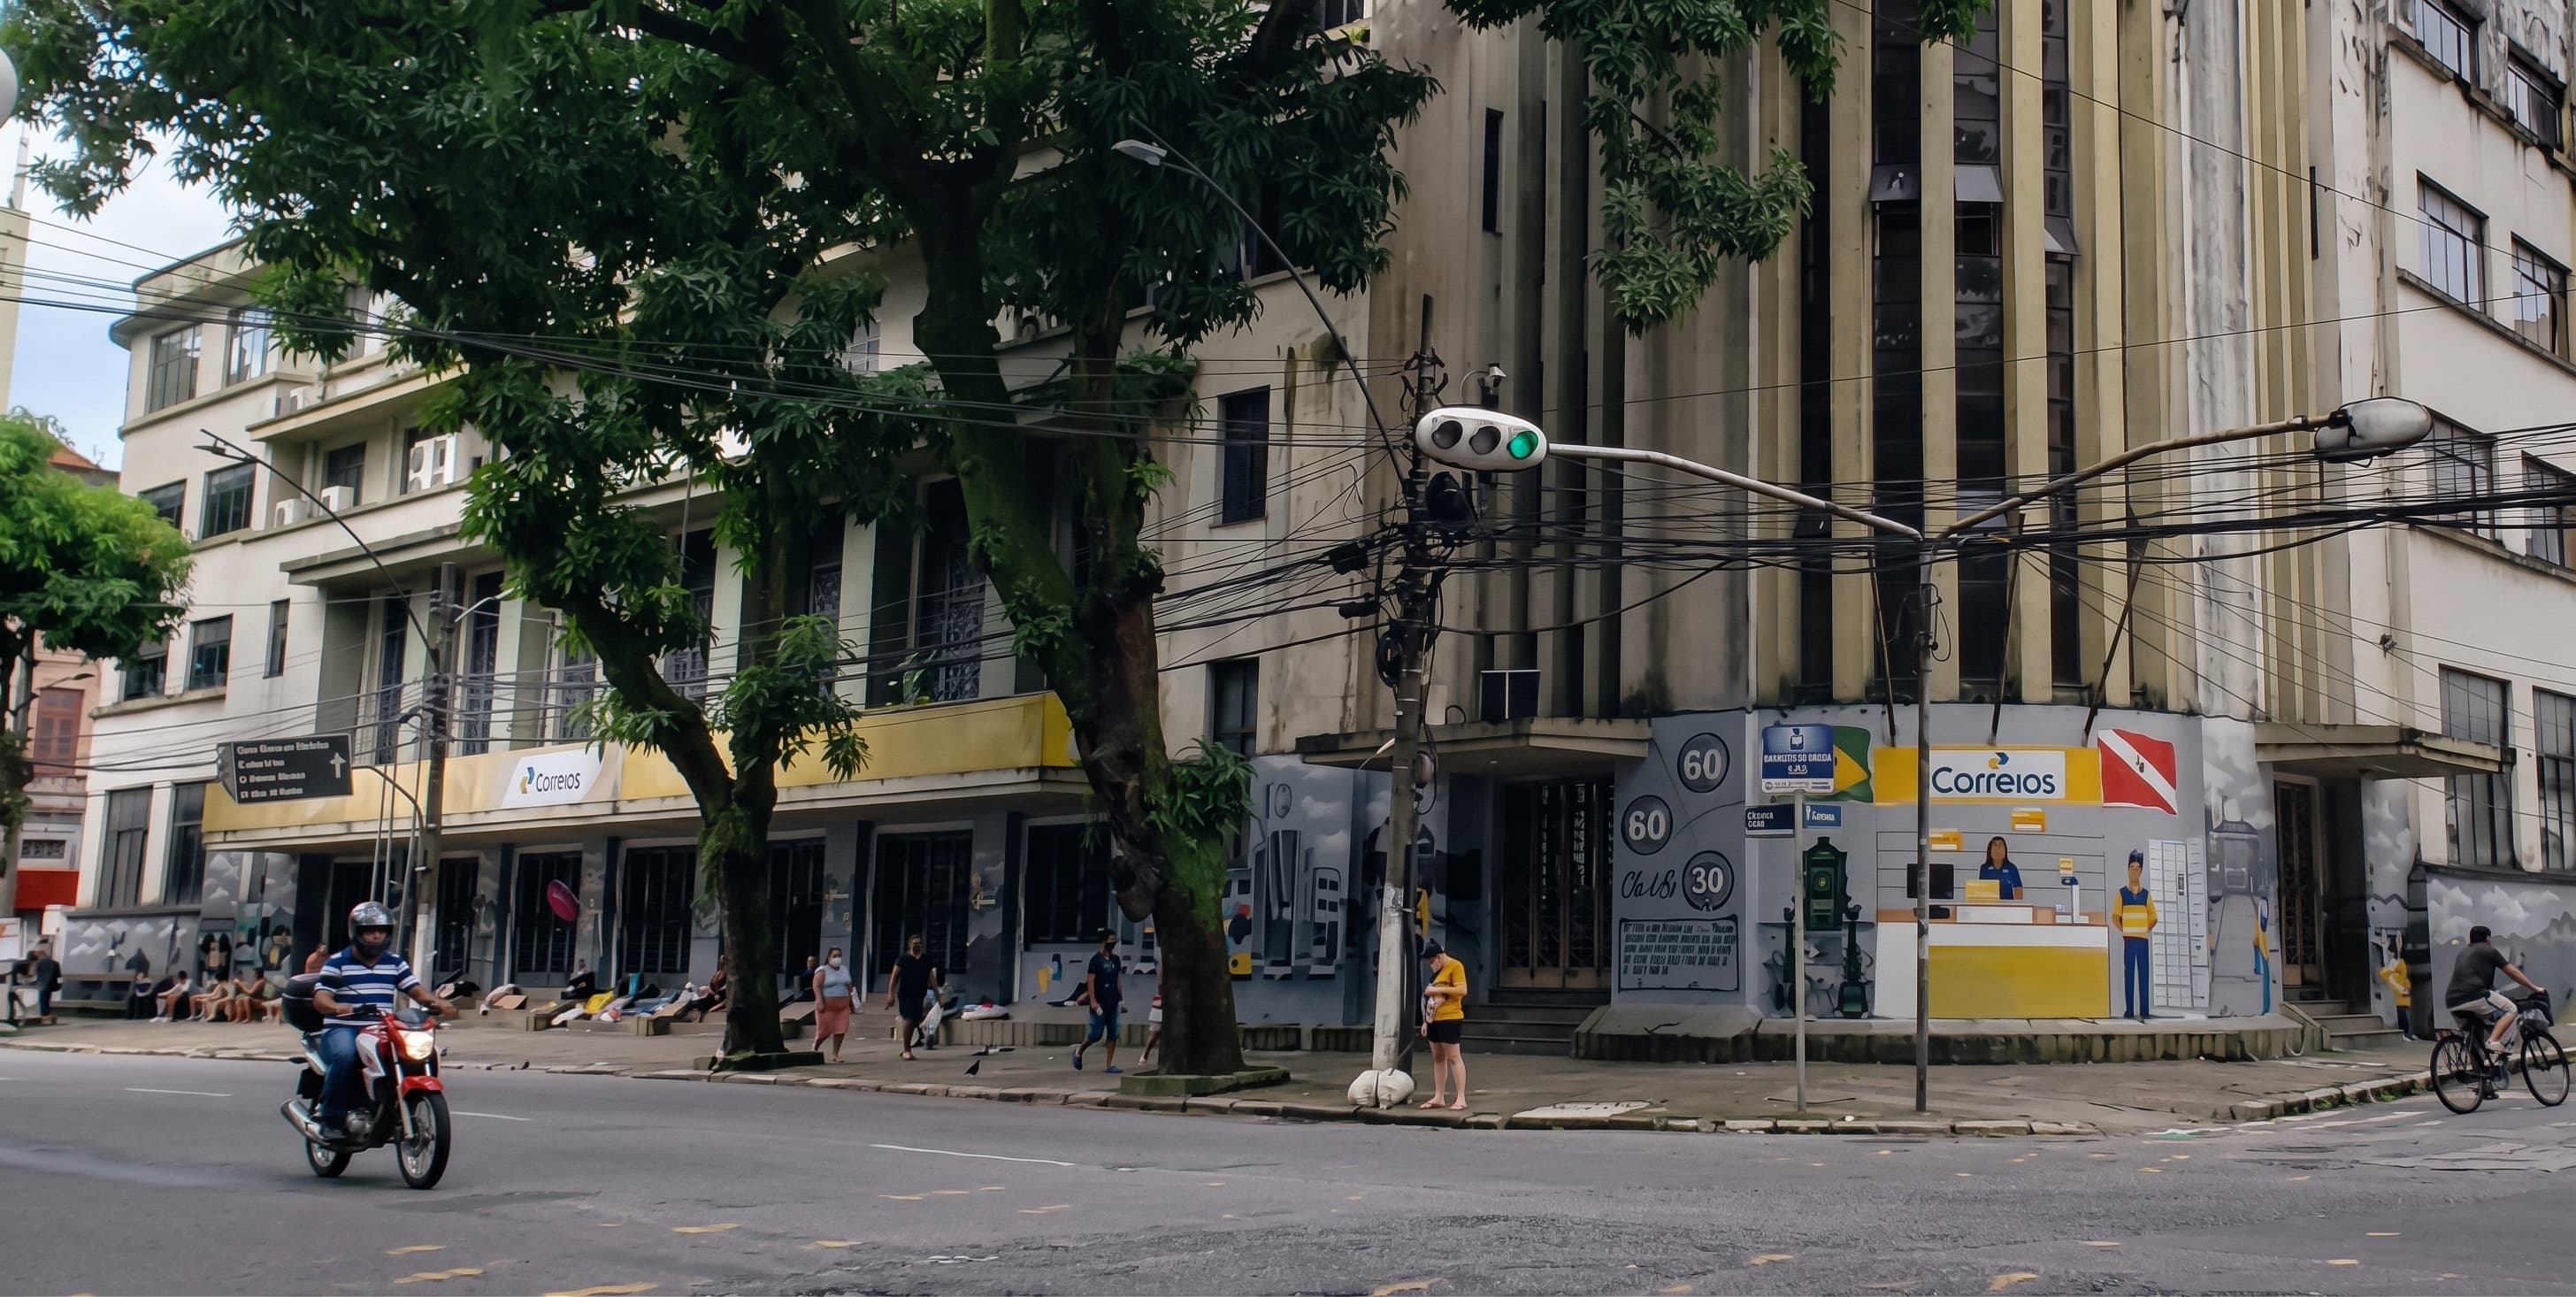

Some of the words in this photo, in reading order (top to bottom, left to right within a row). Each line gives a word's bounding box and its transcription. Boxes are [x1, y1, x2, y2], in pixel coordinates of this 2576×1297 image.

[1683, 748, 1722, 780] 60
[536, 772, 580, 793] Correios
[1931, 766, 2057, 794] Correios
[1629, 810, 1666, 841] 60
[1691, 866, 1724, 894] 30
